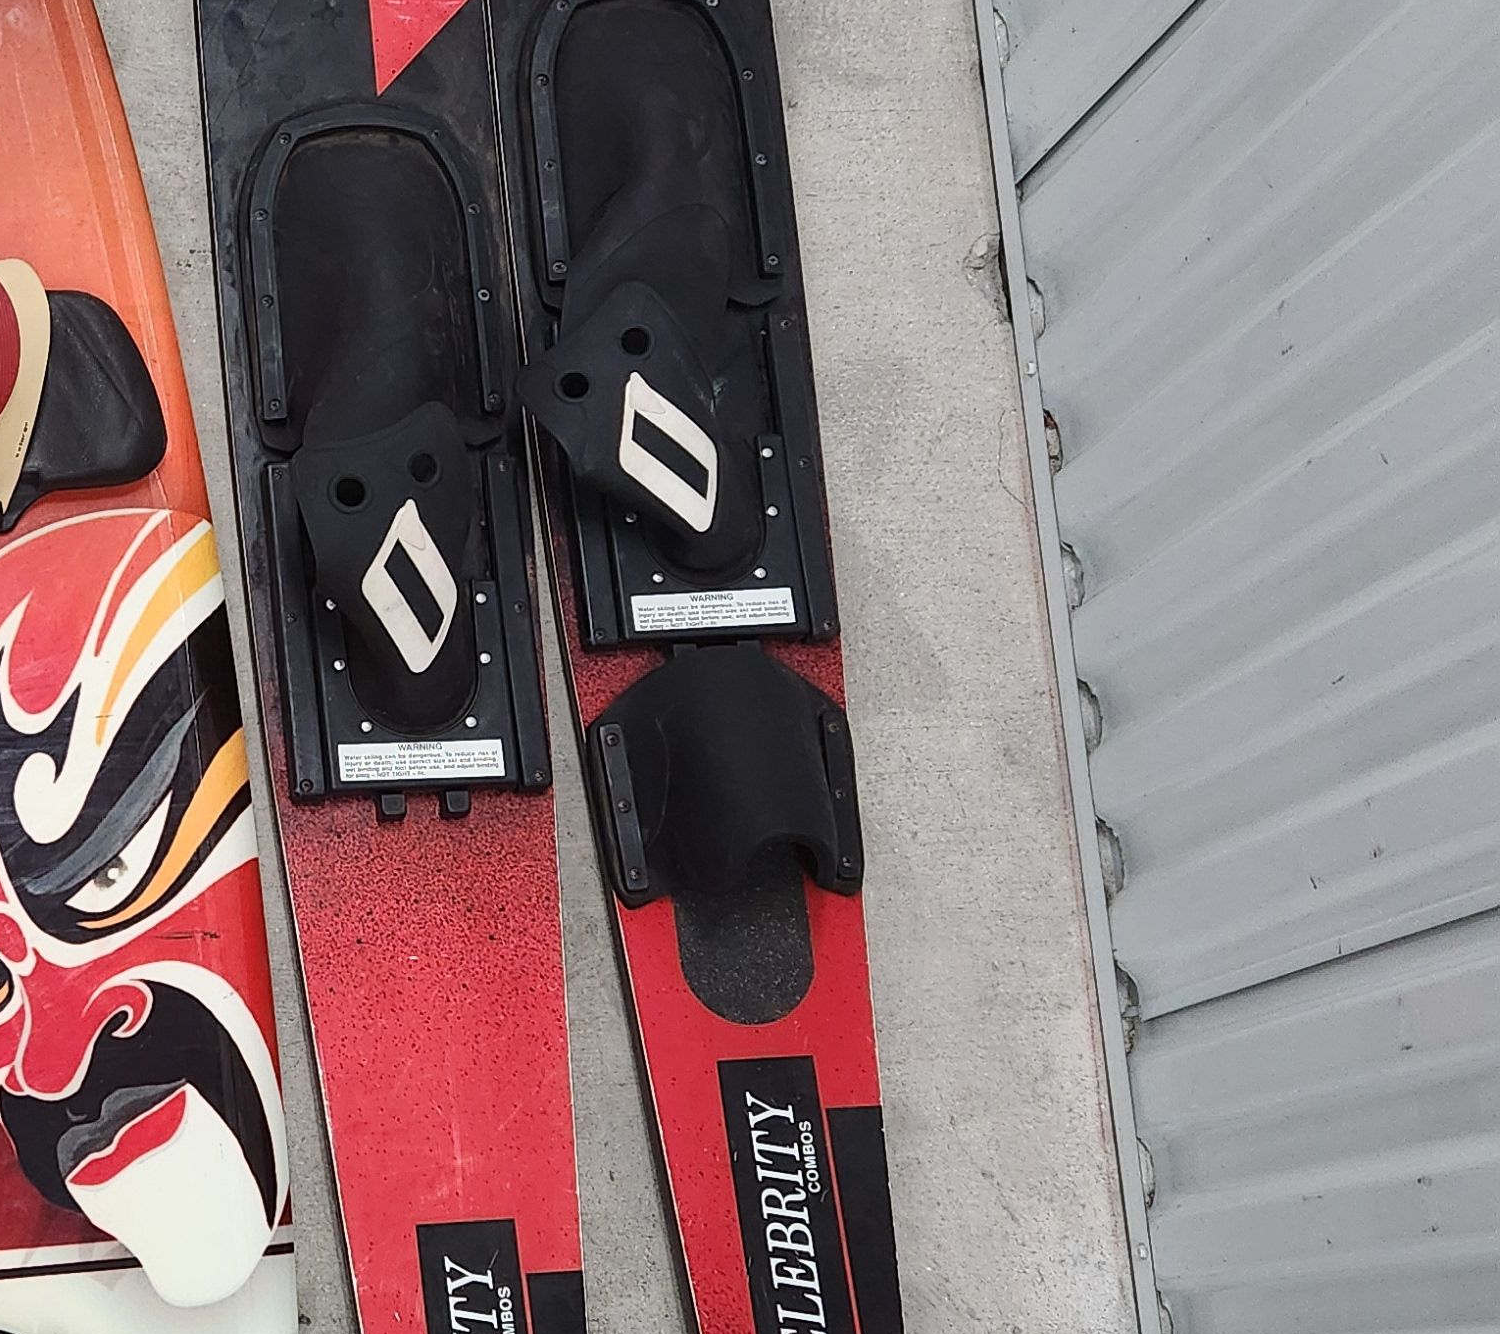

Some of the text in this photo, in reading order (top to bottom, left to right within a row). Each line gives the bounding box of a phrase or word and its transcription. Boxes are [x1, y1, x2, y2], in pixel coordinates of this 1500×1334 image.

[690, 593, 733, 602] WARNING
[398, 742, 442, 751] WARNING
[798, 1120, 823, 1194] COMBOS
